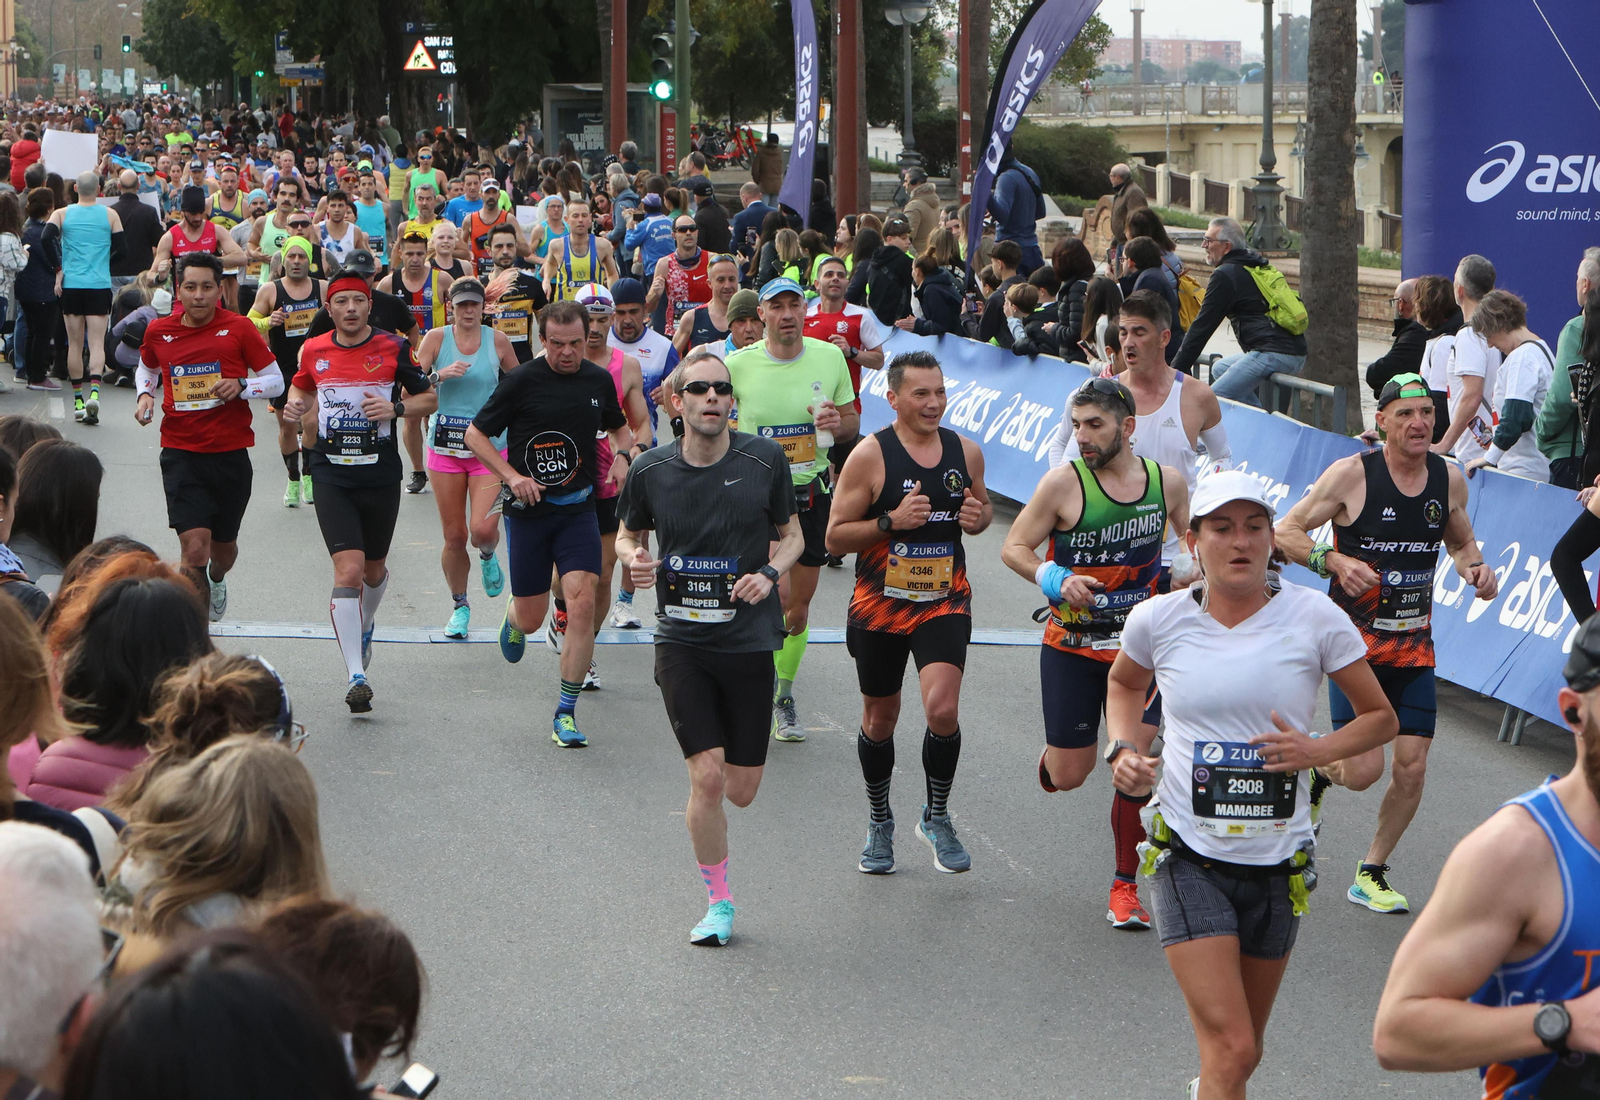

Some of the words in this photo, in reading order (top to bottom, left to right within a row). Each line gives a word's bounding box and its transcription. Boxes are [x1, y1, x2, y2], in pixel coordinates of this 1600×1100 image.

[424, 36, 440, 46] SAN
[1000, 44, 1044, 132] asics
[666, 127, 675, 159] PASEO
[1526, 154, 1600, 193] asi
[1516, 207, 1557, 221] sound
[1559, 207, 1591, 222] mind,
[187, 365, 215, 374] ZURICH
[323, 388, 355, 410] Simón
[950, 385, 1002, 434] asics
[343, 420, 373, 428] ZURICH
[1001, 400, 1054, 453] asics
[777, 426, 809, 436] ZURICH
[342, 436, 361, 444] 2233
[783, 443, 796, 451] 807
[535, 447, 566, 461] RUN
[537, 459, 568, 473] CGN
[1070, 532, 1096, 548] LOS
[1100, 511, 1162, 547] MOJAMAS
[912, 546, 947, 555] ZURICH
[688, 561, 728, 569] ZURICH
[910, 566, 933, 576] 4346
[1406, 572, 1432, 582] ZURICH
[687, 581, 711, 592] 3164
[907, 582, 934, 590] VICTOR
[682, 597, 719, 607] MRSPEED
[1113, 592, 1149, 604] ZURICH
[1402, 593, 1420, 603] 3107
[1228, 778, 1264, 795] 2908
[1215, 803, 1274, 817] MAMABEE
